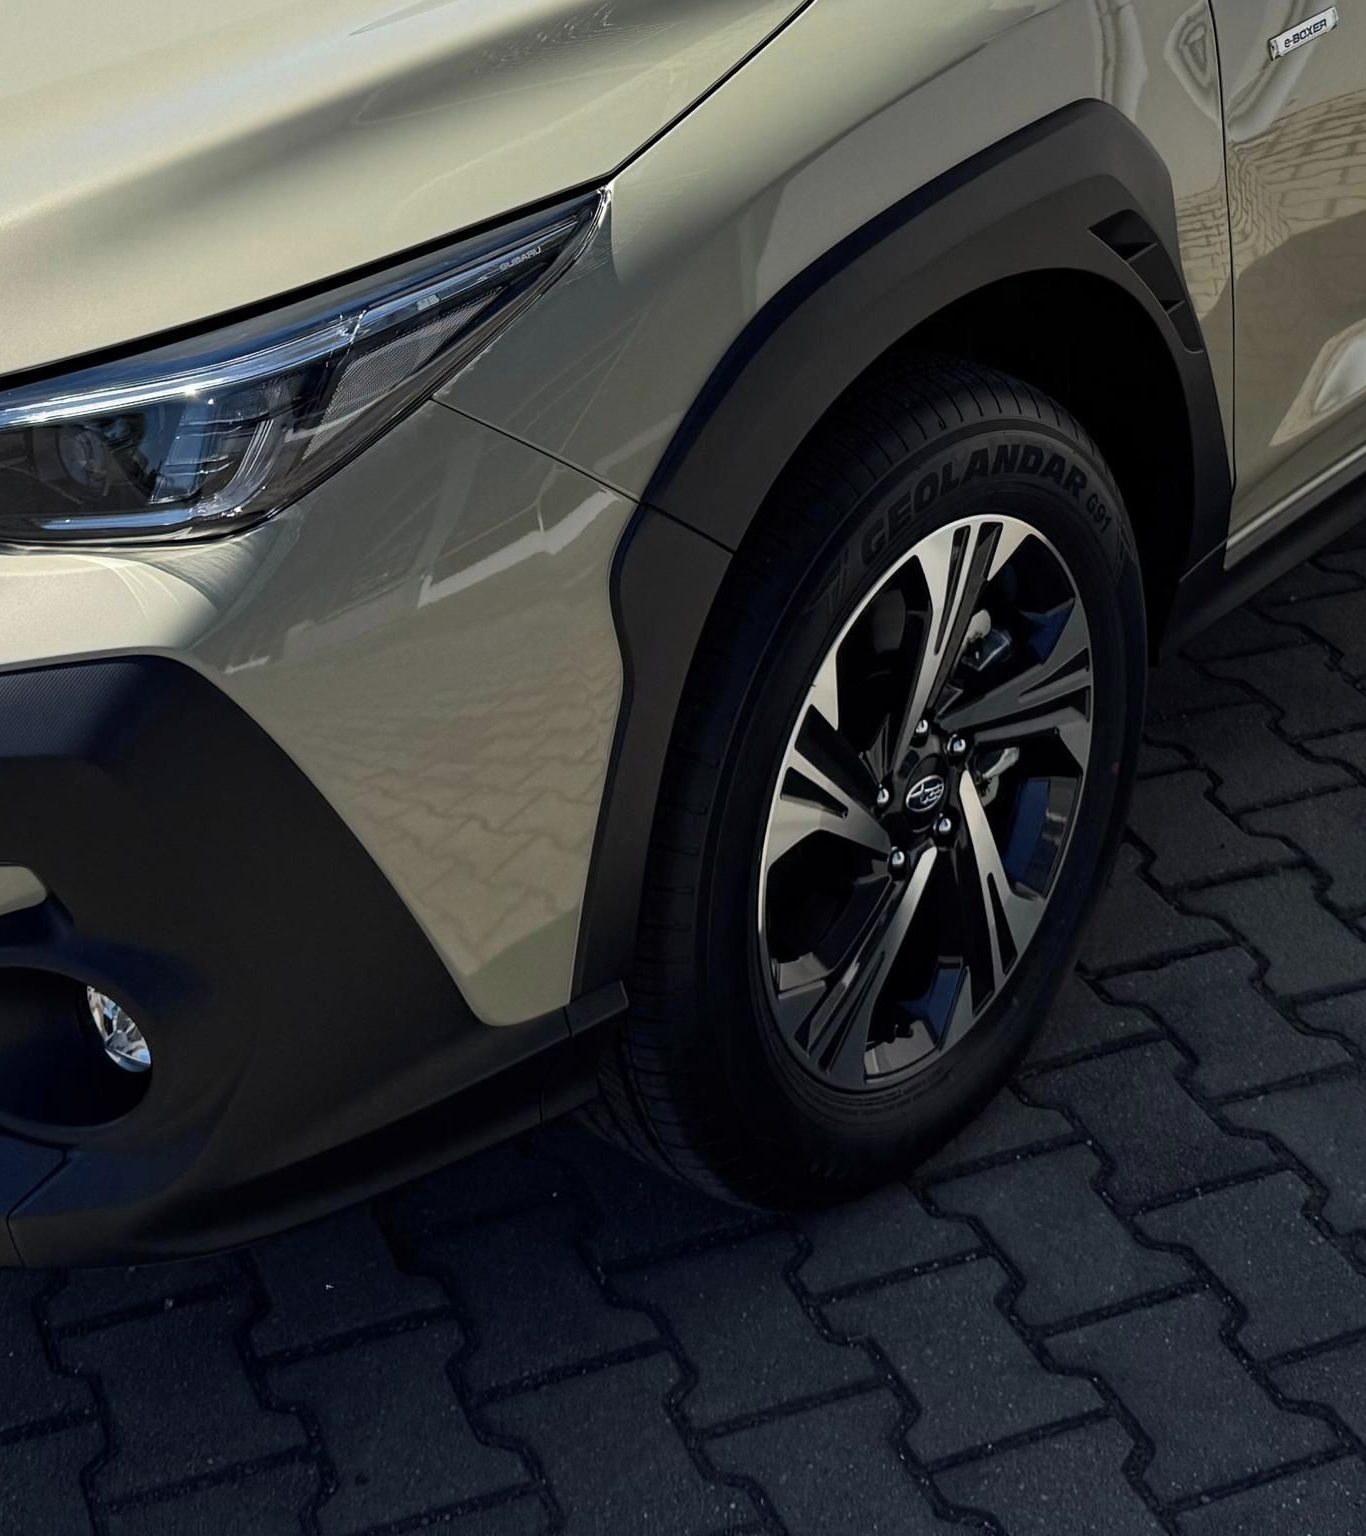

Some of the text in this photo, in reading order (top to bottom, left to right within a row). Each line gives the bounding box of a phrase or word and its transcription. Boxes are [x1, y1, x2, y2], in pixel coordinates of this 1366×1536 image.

[1284, 19, 1327, 48] e-BOXER
[499, 246, 542, 271] SUBARU
[861, 443, 1114, 563] GEOLANDAR G91
